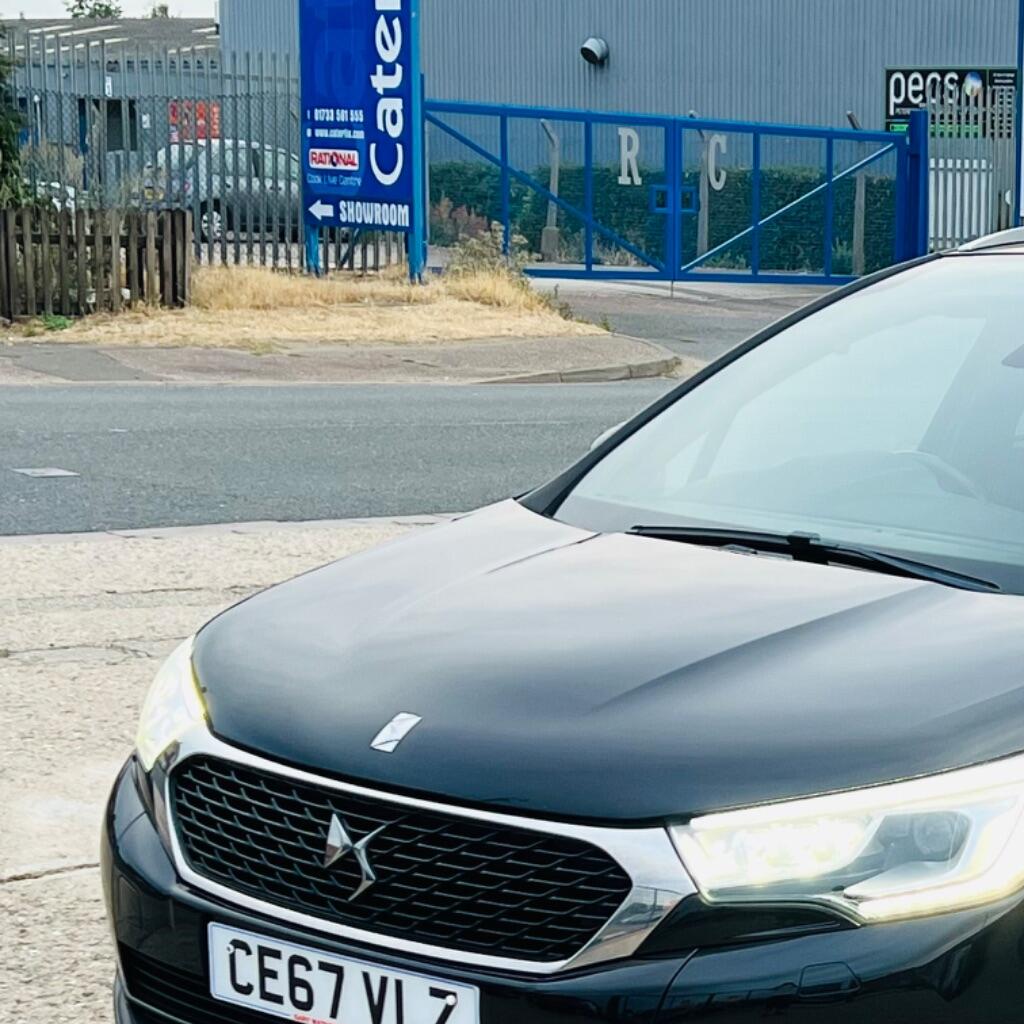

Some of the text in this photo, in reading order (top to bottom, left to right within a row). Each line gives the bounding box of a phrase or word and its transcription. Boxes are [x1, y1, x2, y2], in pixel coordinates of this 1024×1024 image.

[310, 151, 358, 168] RATIONAL
[617, 127, 727, 190] R C
[339, 200, 410, 228] SHOWROOM
[228, 939, 344, 1019] CE67
